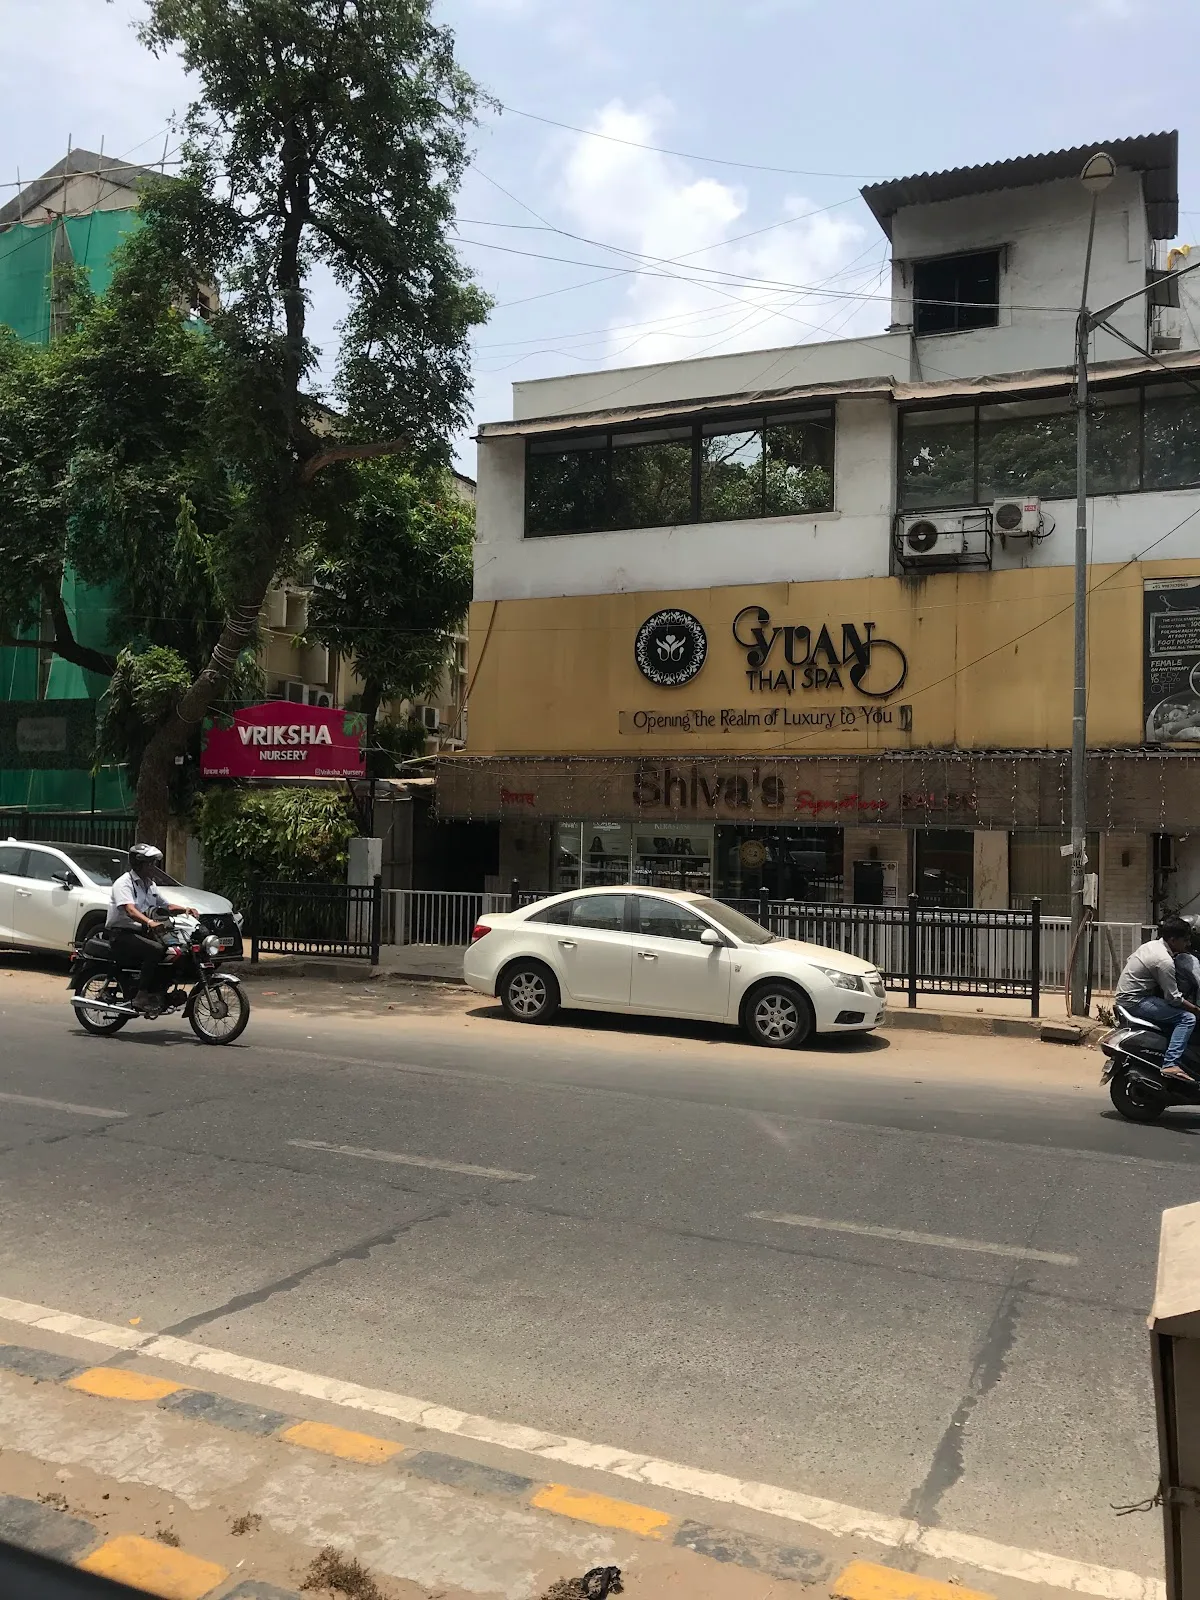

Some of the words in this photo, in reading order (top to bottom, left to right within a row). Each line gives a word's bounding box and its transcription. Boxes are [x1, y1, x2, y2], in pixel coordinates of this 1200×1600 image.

[732, 605, 908, 697] YUAN
[1150, 658, 1183, 668] FEMALE
[745, 669, 796, 692] THAI
[801, 667, 844, 689] SPA
[1150, 682, 1176, 694] OFF
[1160, 671, 1181, 683] 55%
[633, 709, 690, 733] Opening
[694, 710, 716, 727] the
[720, 708, 761, 727] Realm
[763, 708, 782, 726] of
[783, 707, 834, 730] Luxury
[840, 709, 856, 726] to
[861, 706, 893, 725] You
[237, 724, 333, 746] VRIKSHA
[259, 750, 308, 761] NURSERY
[632, 762, 786, 811] Shiva's
